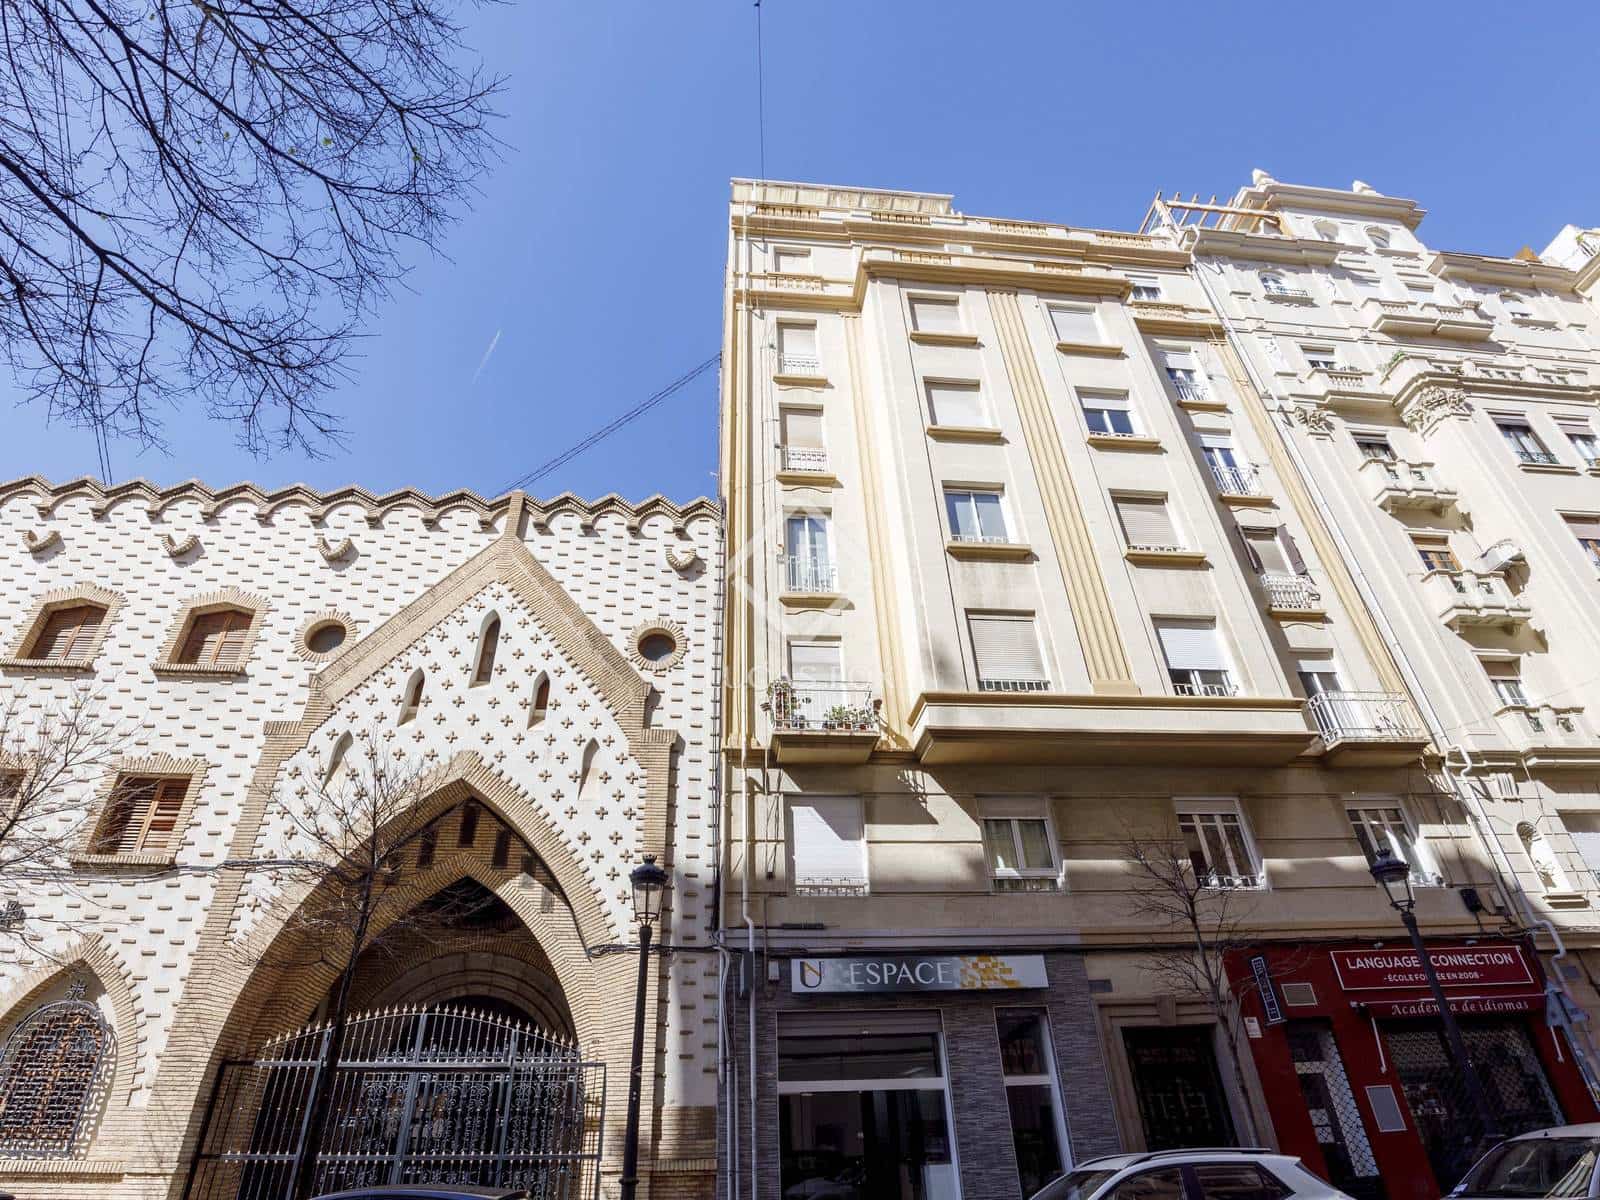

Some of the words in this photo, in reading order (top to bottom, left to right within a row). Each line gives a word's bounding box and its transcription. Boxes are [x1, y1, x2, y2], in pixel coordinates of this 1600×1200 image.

[1346, 955, 1421, 969] LANGUAGE
[1429, 952, 1514, 967] CONNECTION
[849, 961, 954, 985] ESPACE
[1391, 1001, 1458, 1016] Academa
[1462, 1000, 1477, 1013] de
[1479, 999, 1529, 1012] idiomas
